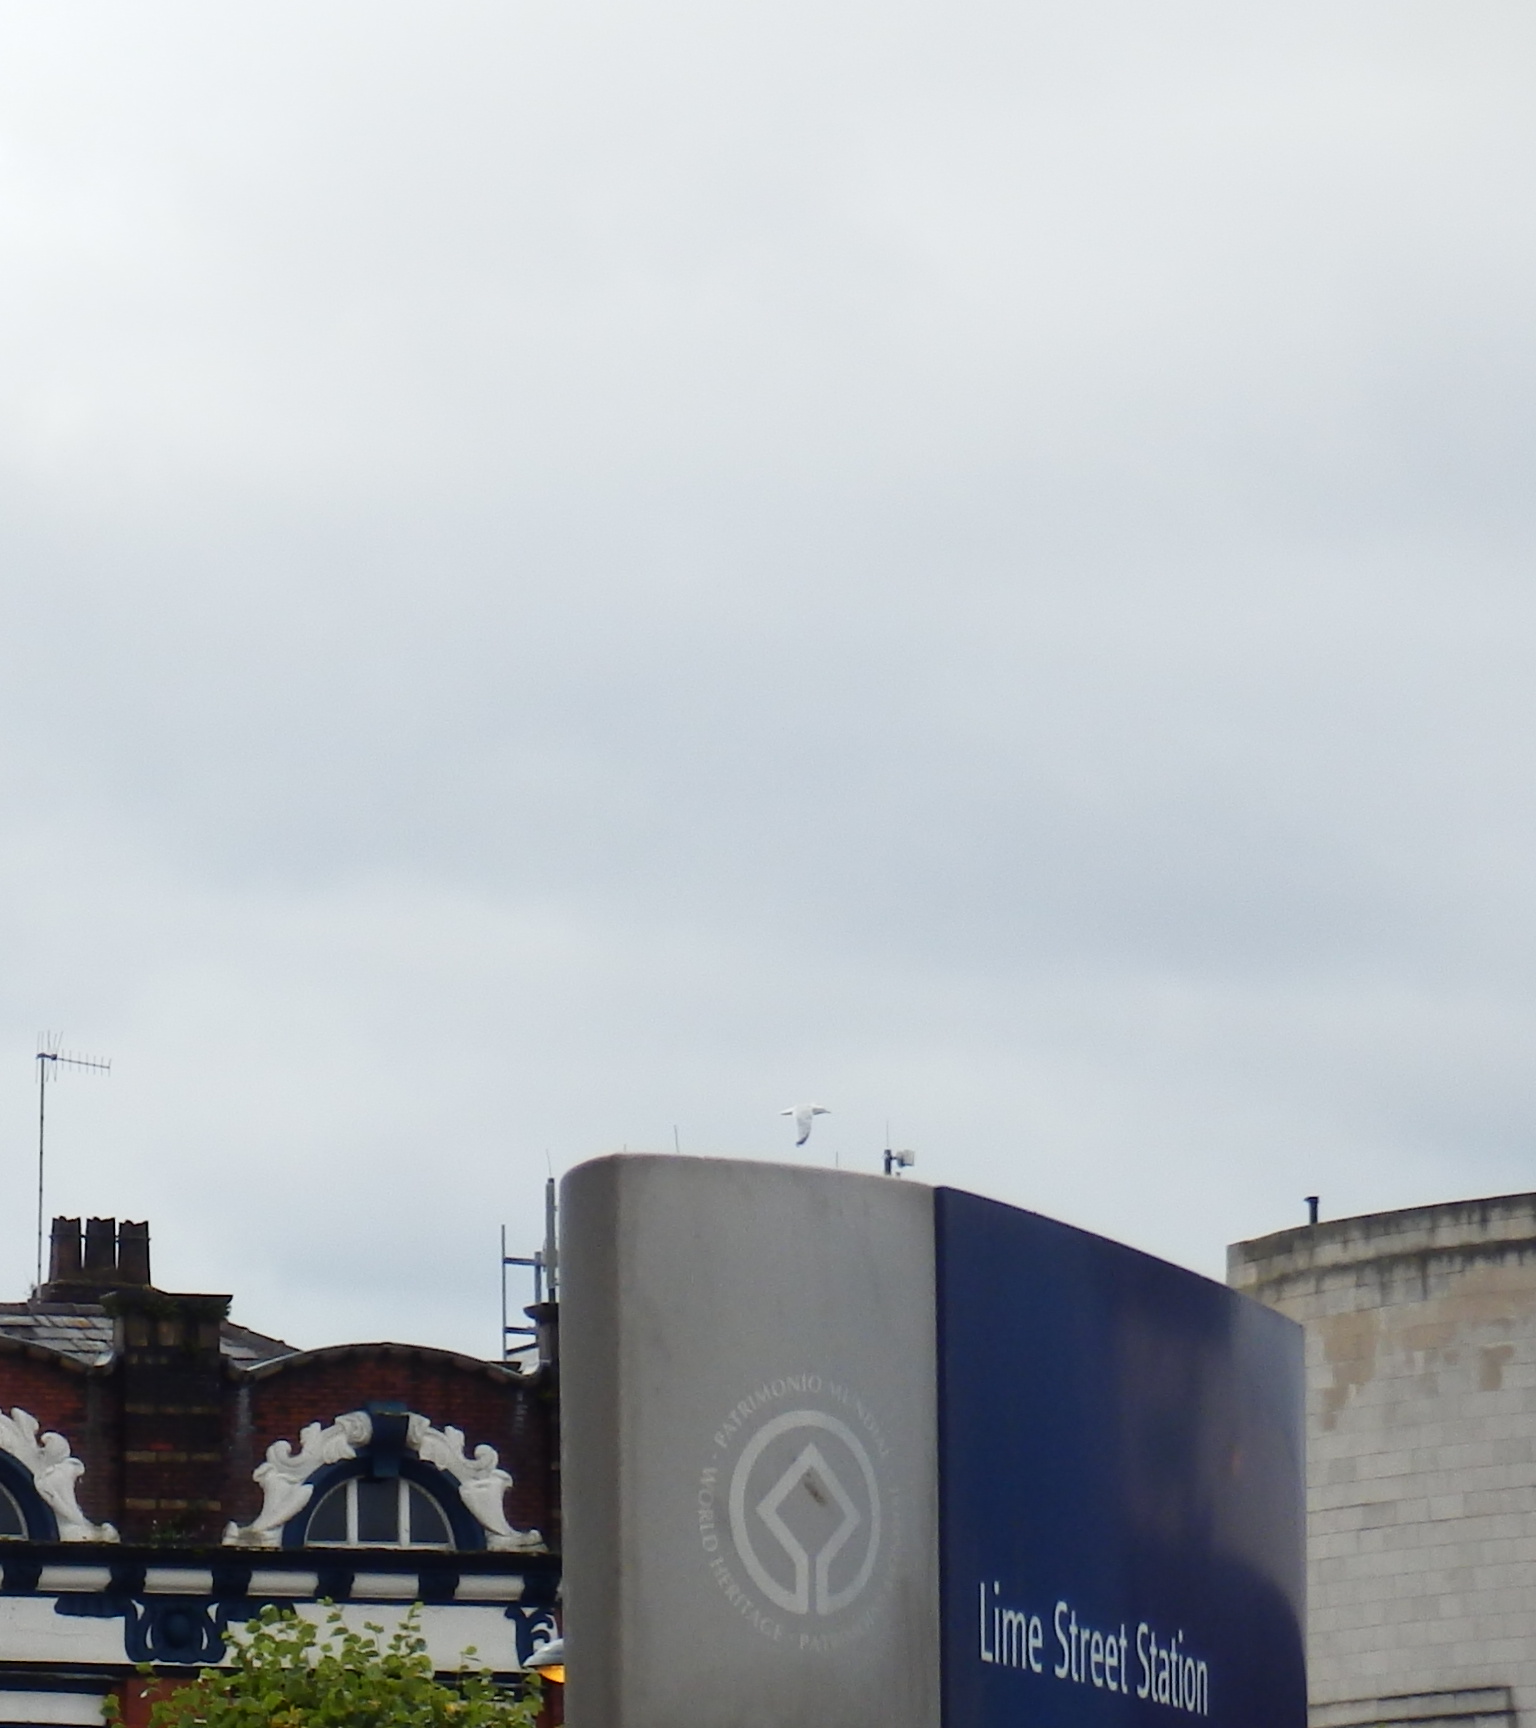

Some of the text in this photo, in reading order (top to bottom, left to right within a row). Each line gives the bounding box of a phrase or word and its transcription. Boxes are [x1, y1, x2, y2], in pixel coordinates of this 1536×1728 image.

[714, 1372, 822, 1449] PATRIMONIO
[697, 1466, 783, 1641] WORLD HERITAGE
[980, 1581, 1208, 1717] Lime Street Station
